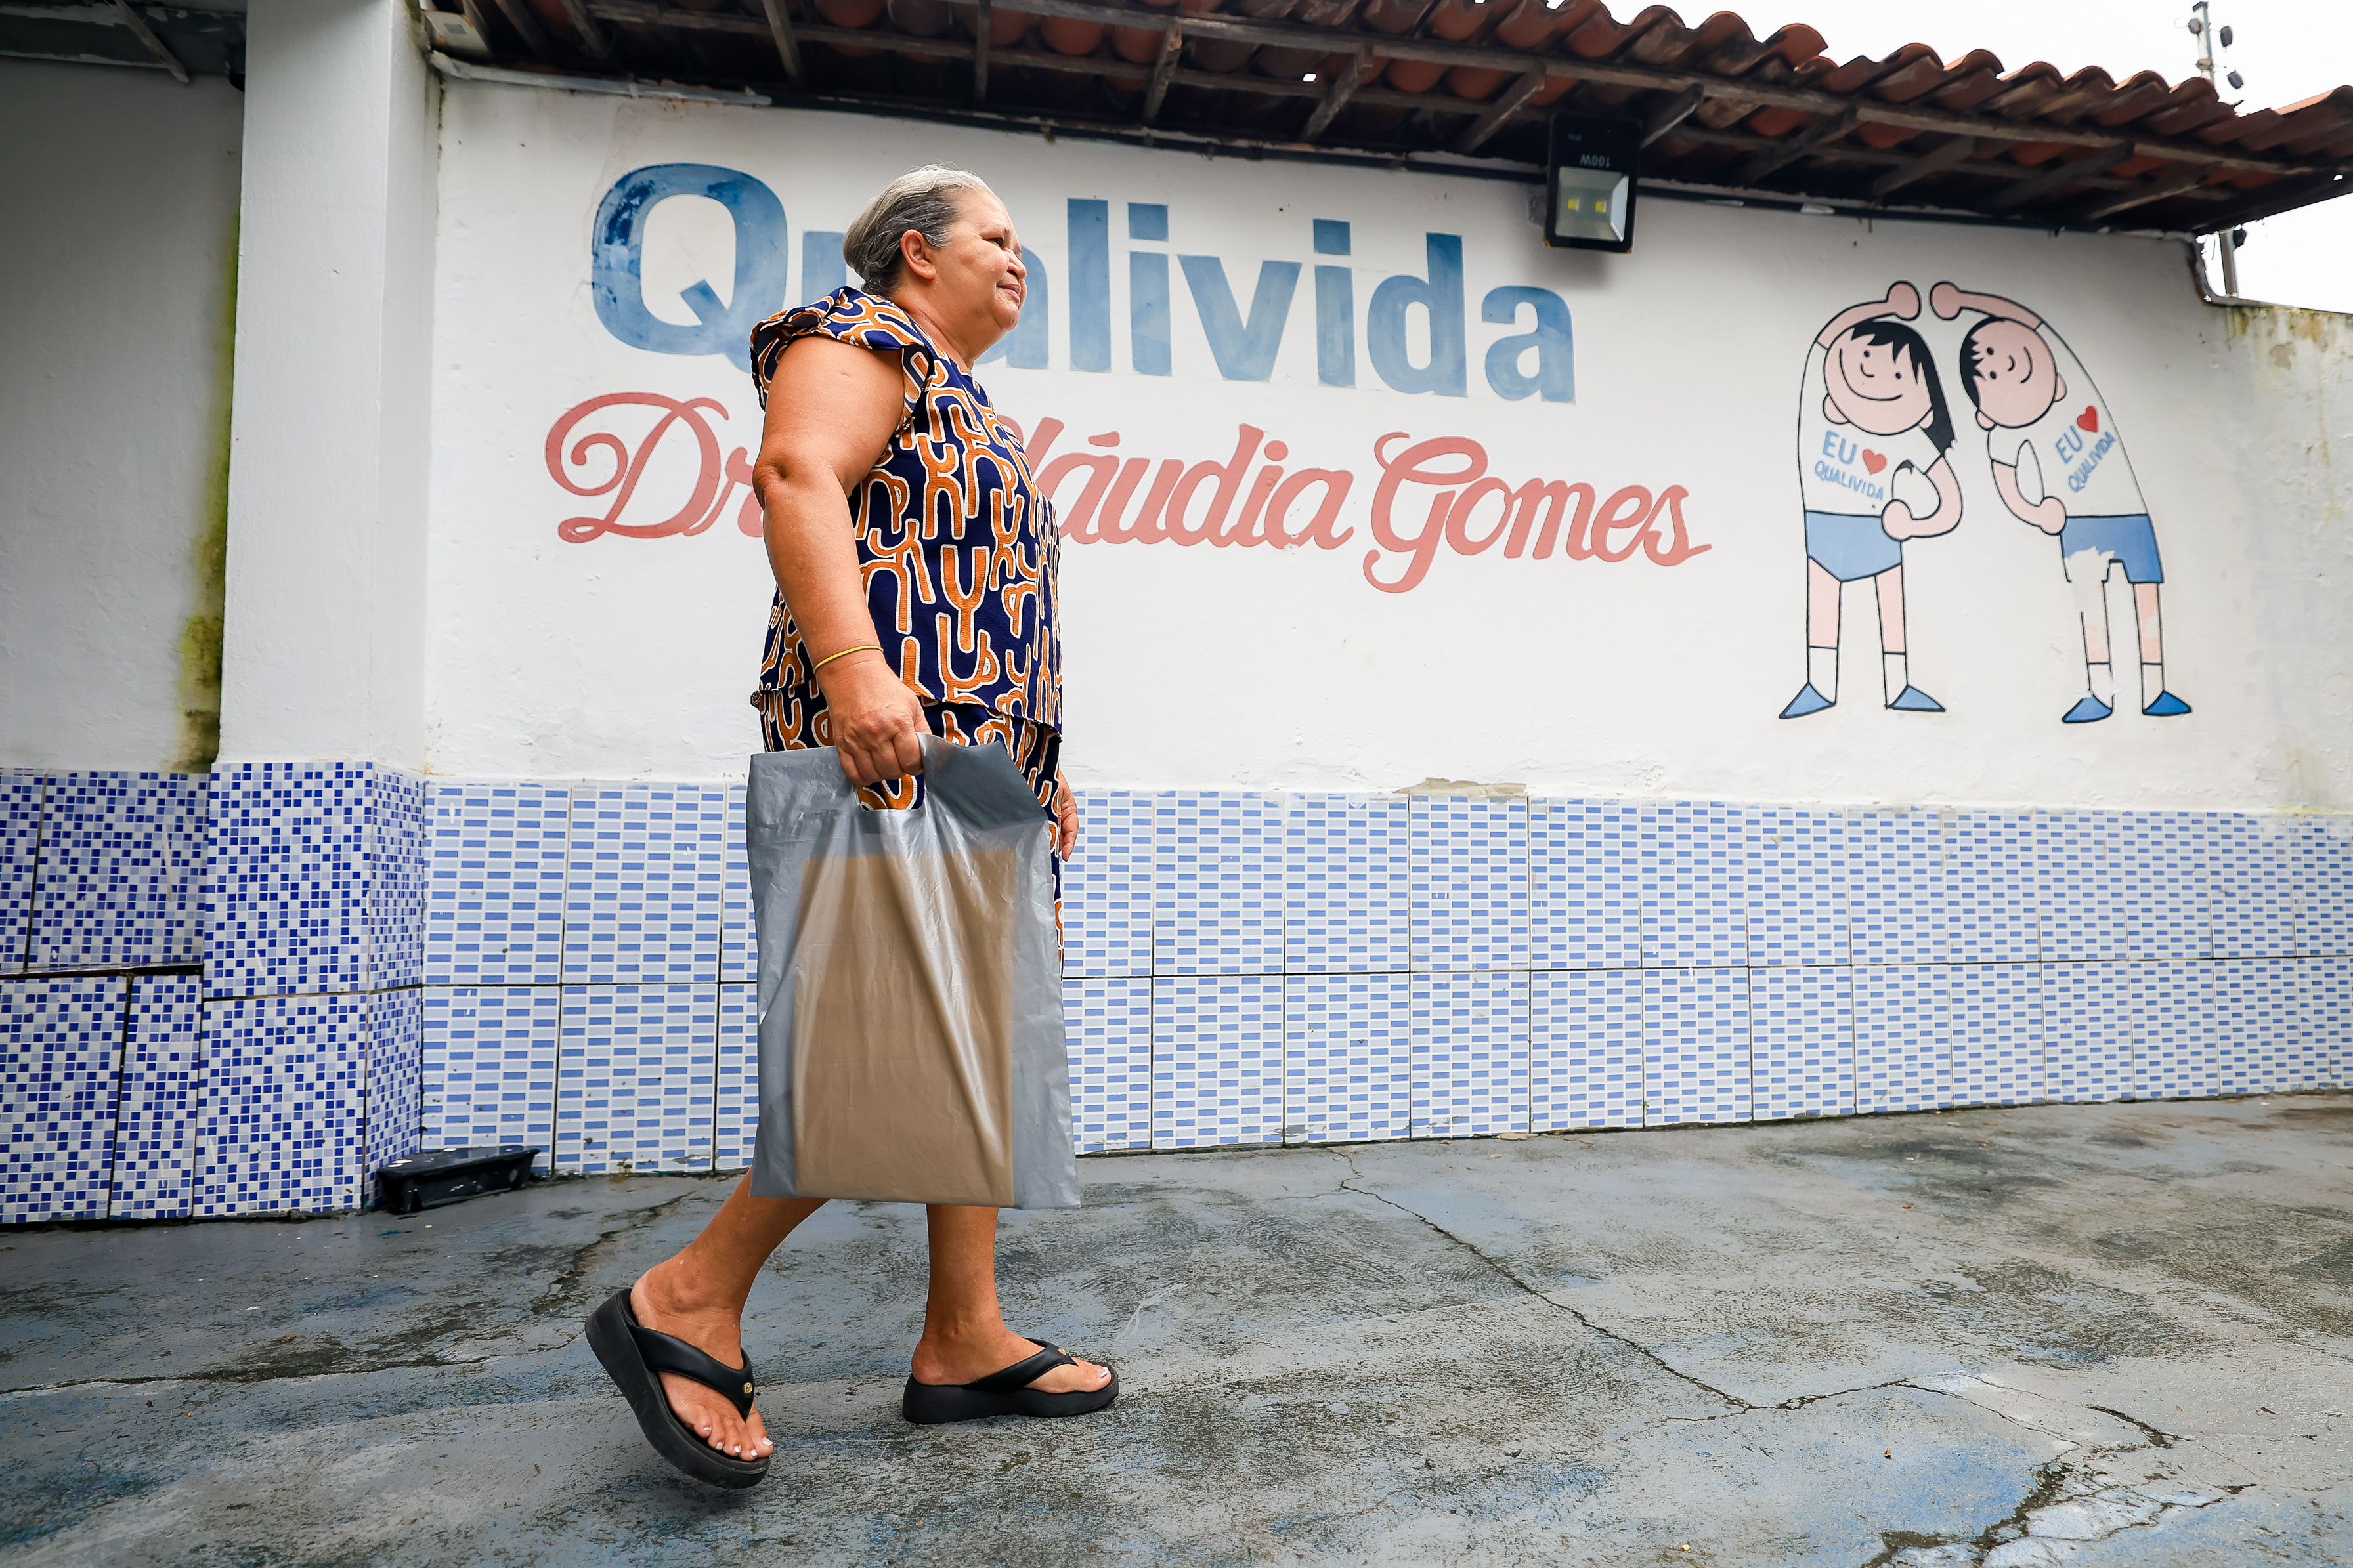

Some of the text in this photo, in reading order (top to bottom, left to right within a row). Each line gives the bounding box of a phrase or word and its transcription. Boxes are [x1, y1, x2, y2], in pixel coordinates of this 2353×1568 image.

[1580, 154, 1610, 167] 100W
[1823, 430, 1858, 465] EU
[2055, 425, 2084, 464] EU
[2068, 431, 2115, 492] QUALIVIDA
[545, 392, 1713, 594] Dr láudia Gomes
[1814, 460, 1885, 501] QUALIVIDA
